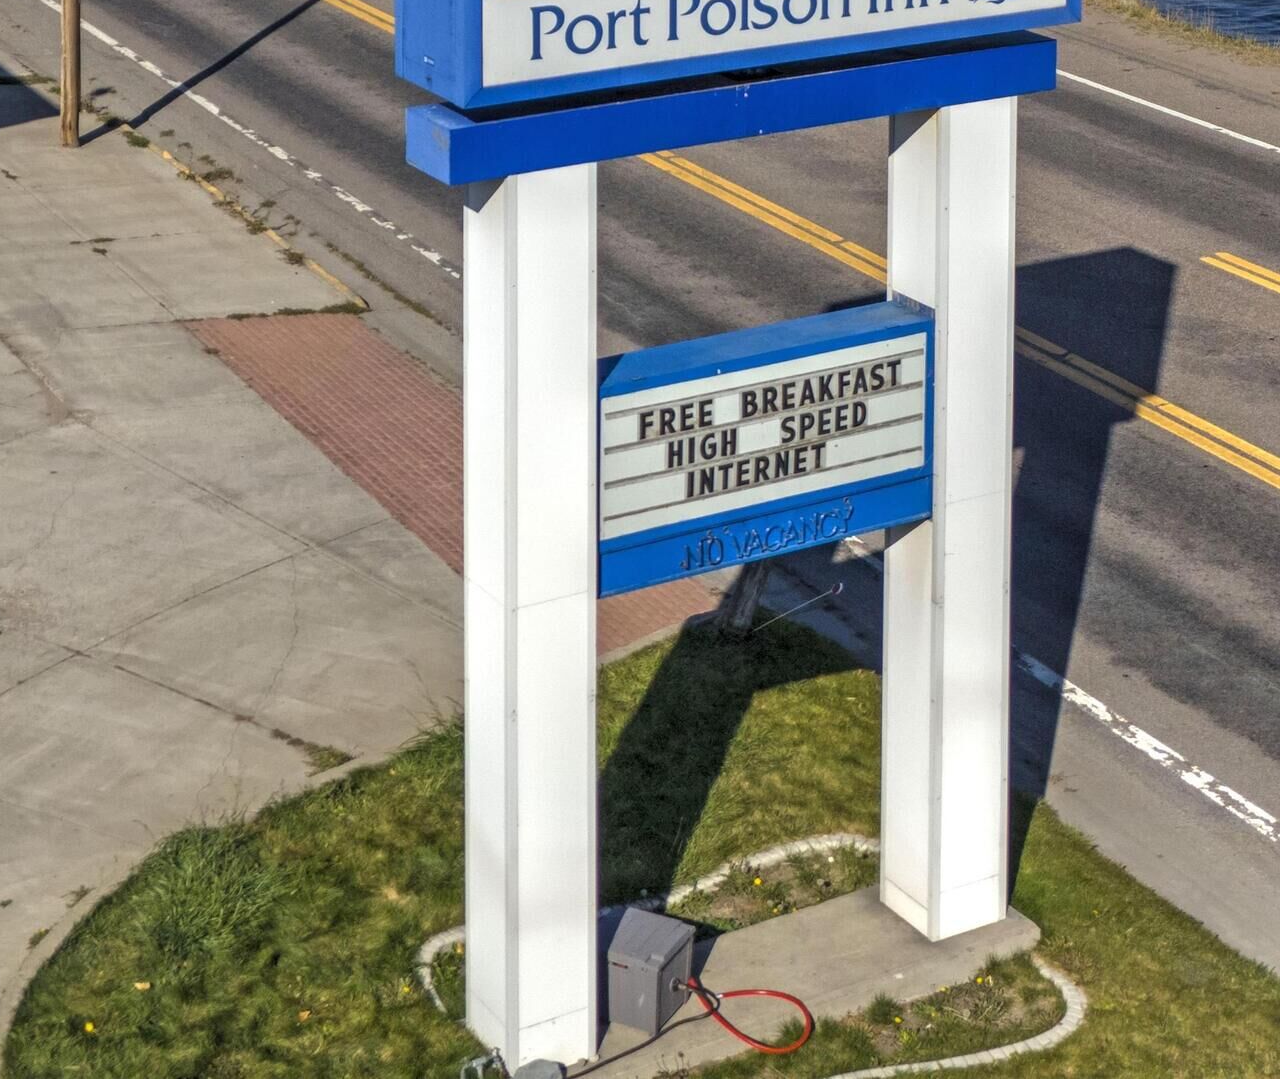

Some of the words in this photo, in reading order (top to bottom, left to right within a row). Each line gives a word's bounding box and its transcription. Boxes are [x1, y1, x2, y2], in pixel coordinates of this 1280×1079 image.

[639, 398, 714, 440] FREE
[741, 359, 902, 419] BREAKFAST
[667, 427, 738, 469] HIGH
[780, 401, 868, 444] SPEED
[686, 441, 827, 498] INTERNET
[680, 533, 724, 570] NO
[731, 500, 854, 559] VACANCY
